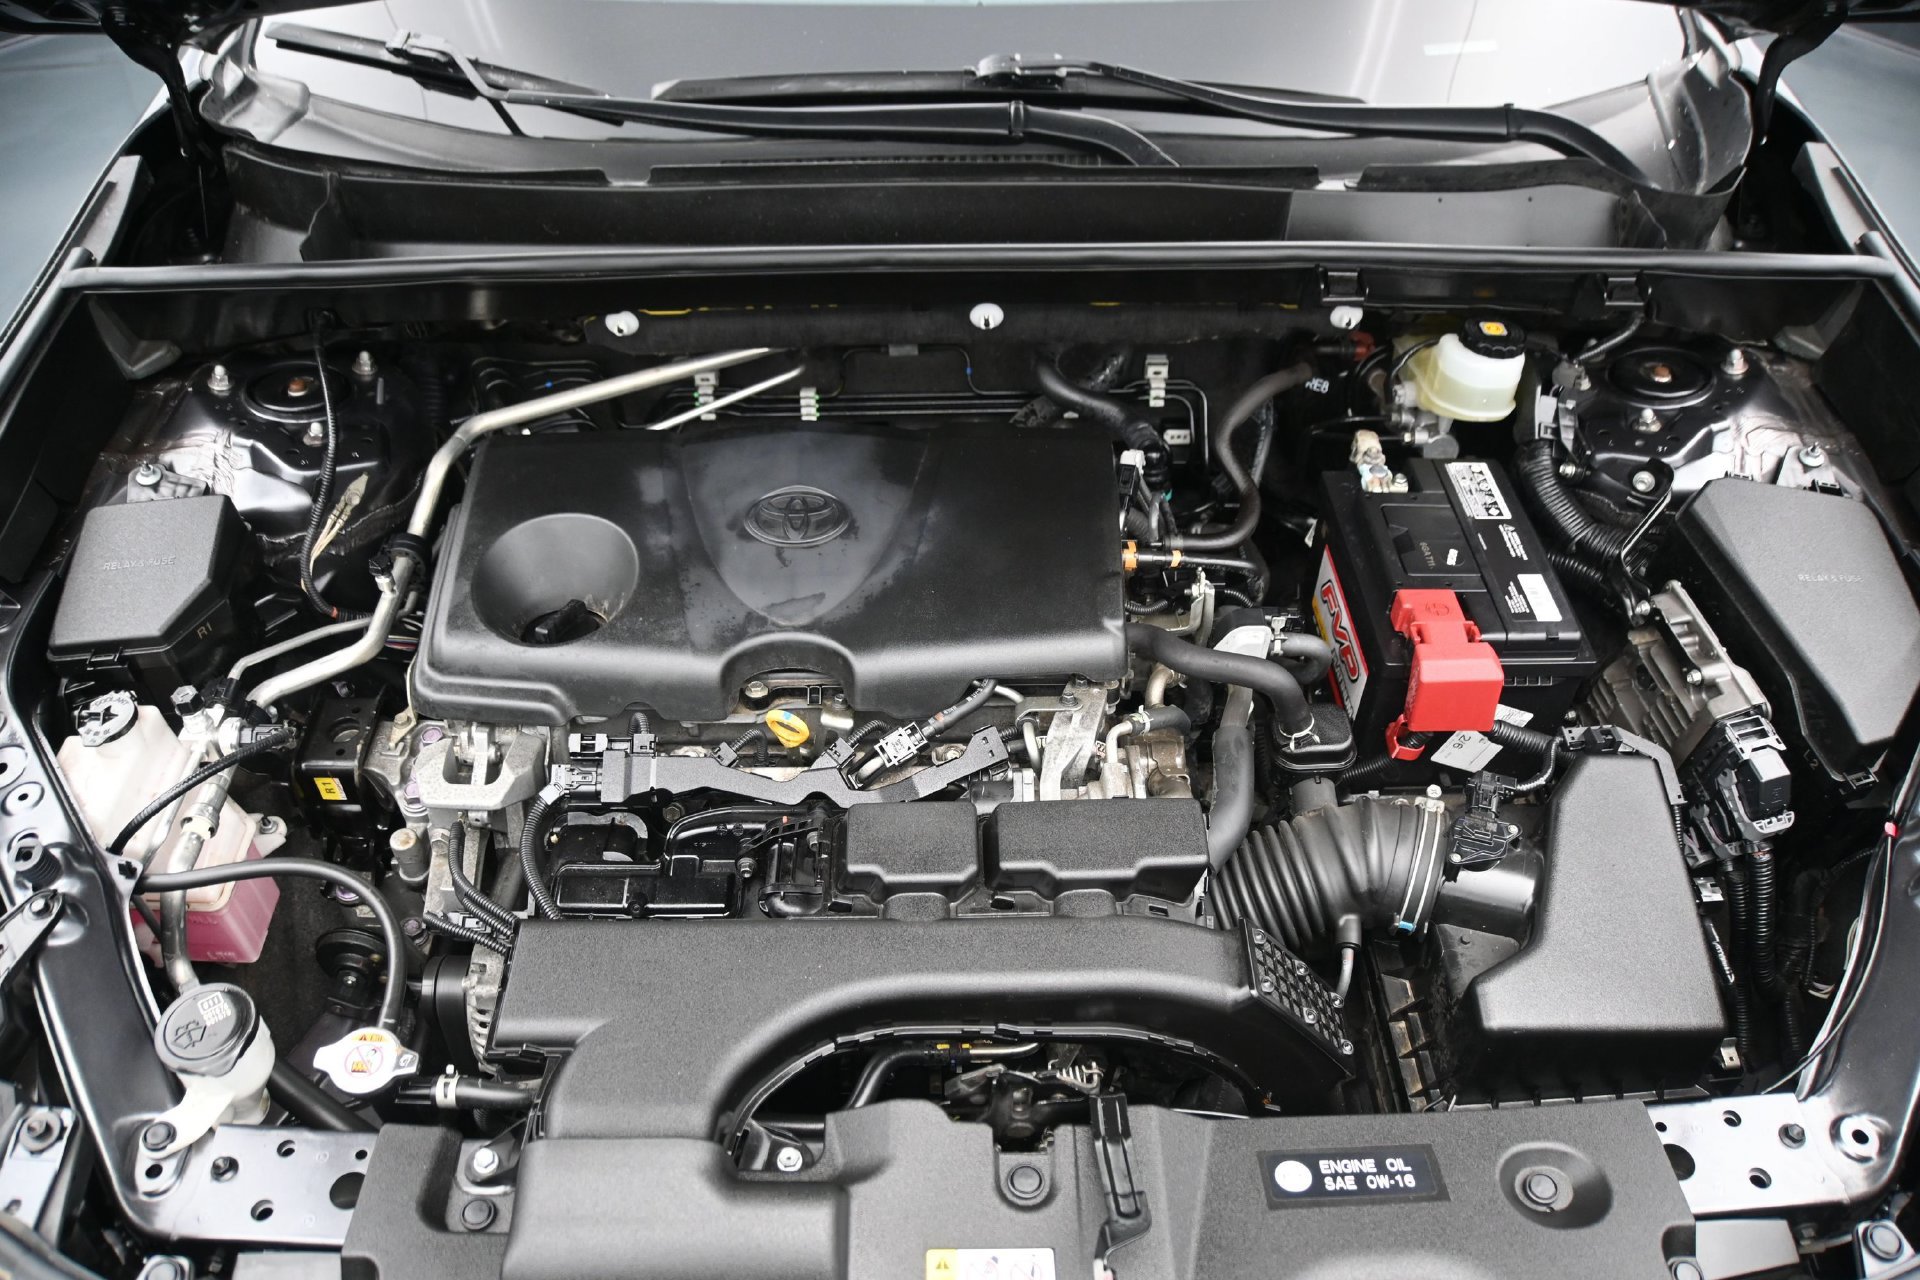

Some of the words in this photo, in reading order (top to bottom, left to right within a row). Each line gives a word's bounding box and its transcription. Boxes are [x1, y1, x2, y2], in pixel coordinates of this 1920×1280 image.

[1321, 580, 1360, 682] FVP
[1319, 1159, 1377, 1174] ENGINE
[1386, 1158, 1412, 1172] OIL
[1324, 1175, 1357, 1191] SAE
